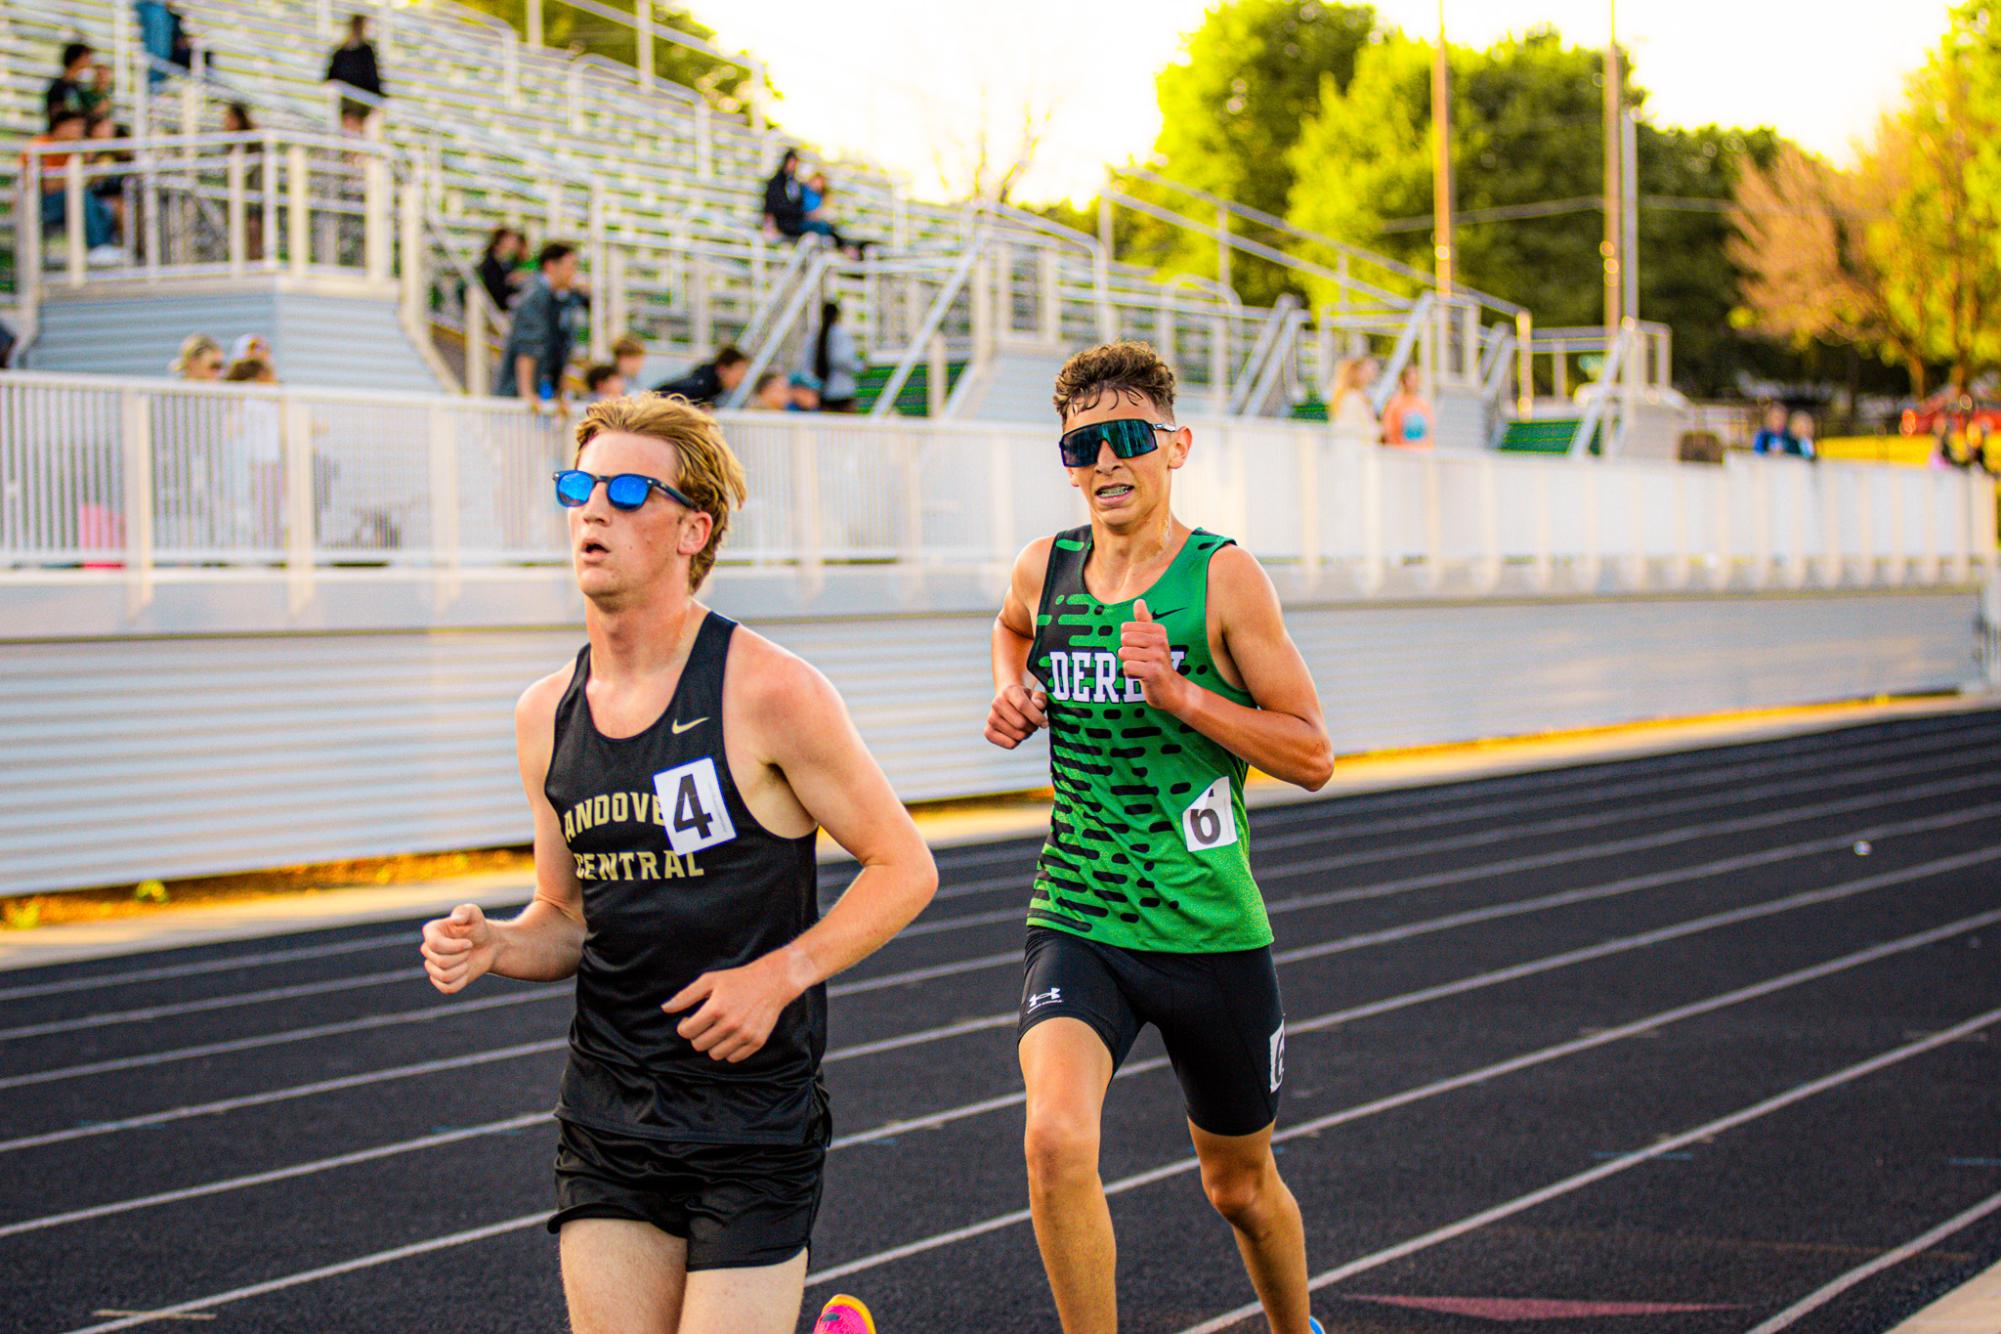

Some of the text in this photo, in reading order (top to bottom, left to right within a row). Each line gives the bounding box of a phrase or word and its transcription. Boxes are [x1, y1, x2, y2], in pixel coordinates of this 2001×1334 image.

[563, 791, 665, 843] ANDOVE
[674, 773, 713, 840] 4
[573, 849, 705, 881] CENTRAL
